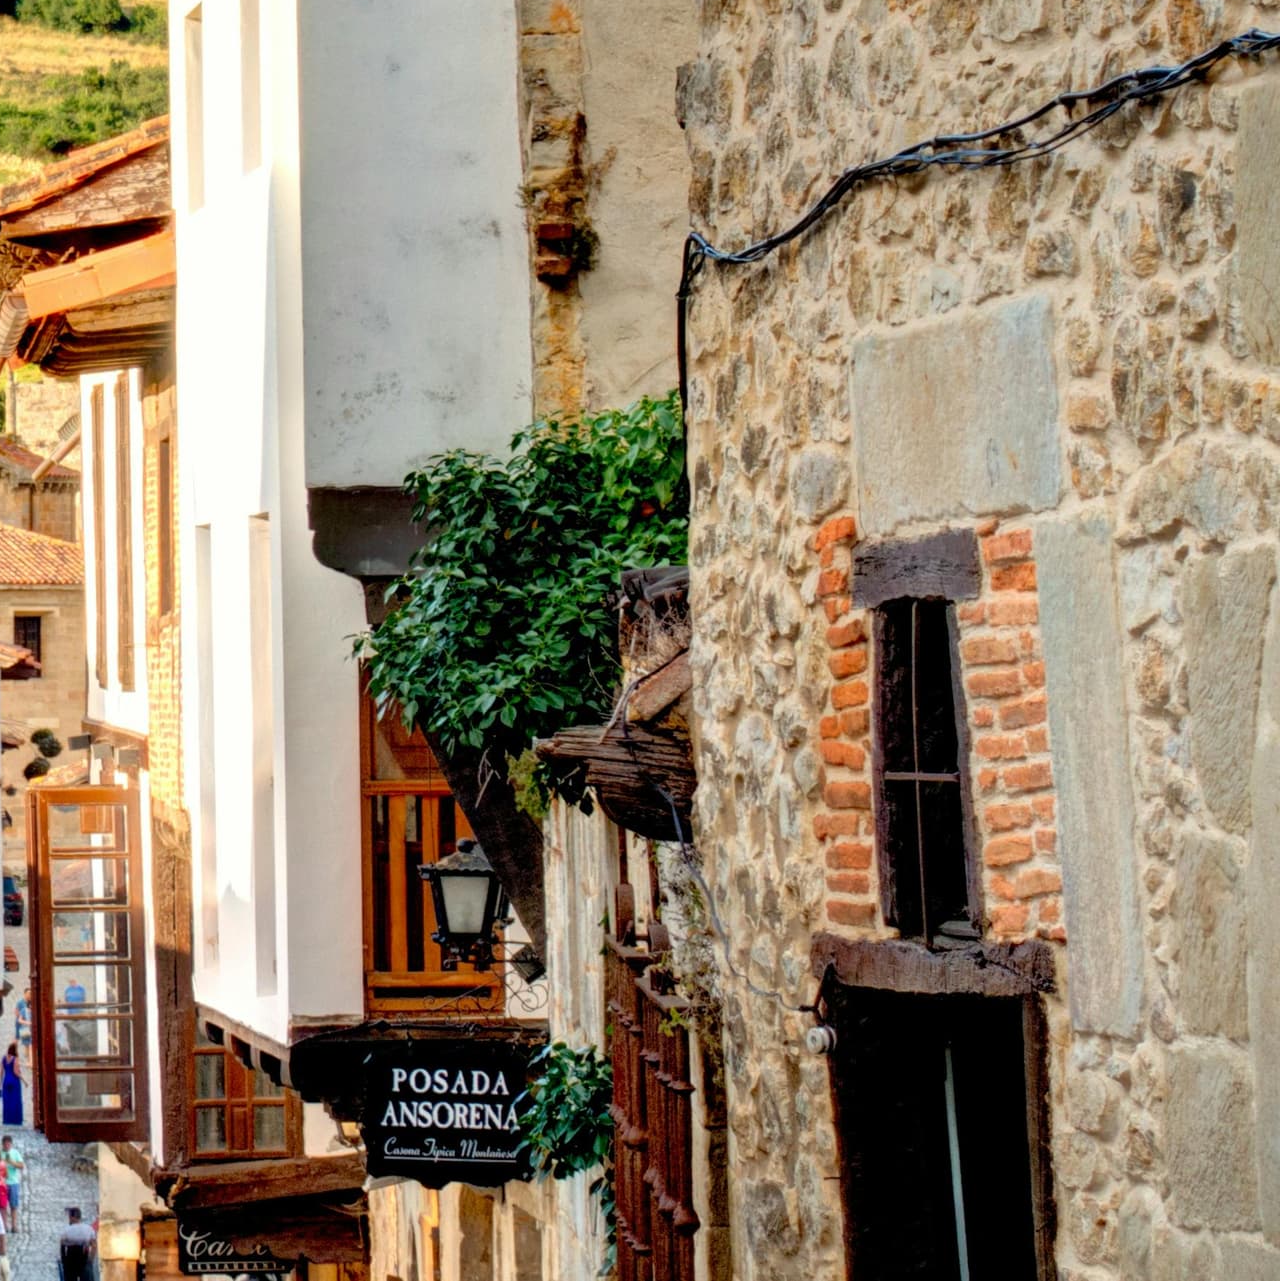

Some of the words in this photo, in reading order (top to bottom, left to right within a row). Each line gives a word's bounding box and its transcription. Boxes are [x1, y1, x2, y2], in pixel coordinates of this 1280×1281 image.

[391, 1068, 510, 1096] POSADA
[380, 1100, 521, 1133] ANSORENA
[383, 1136, 421, 1156] Casona
